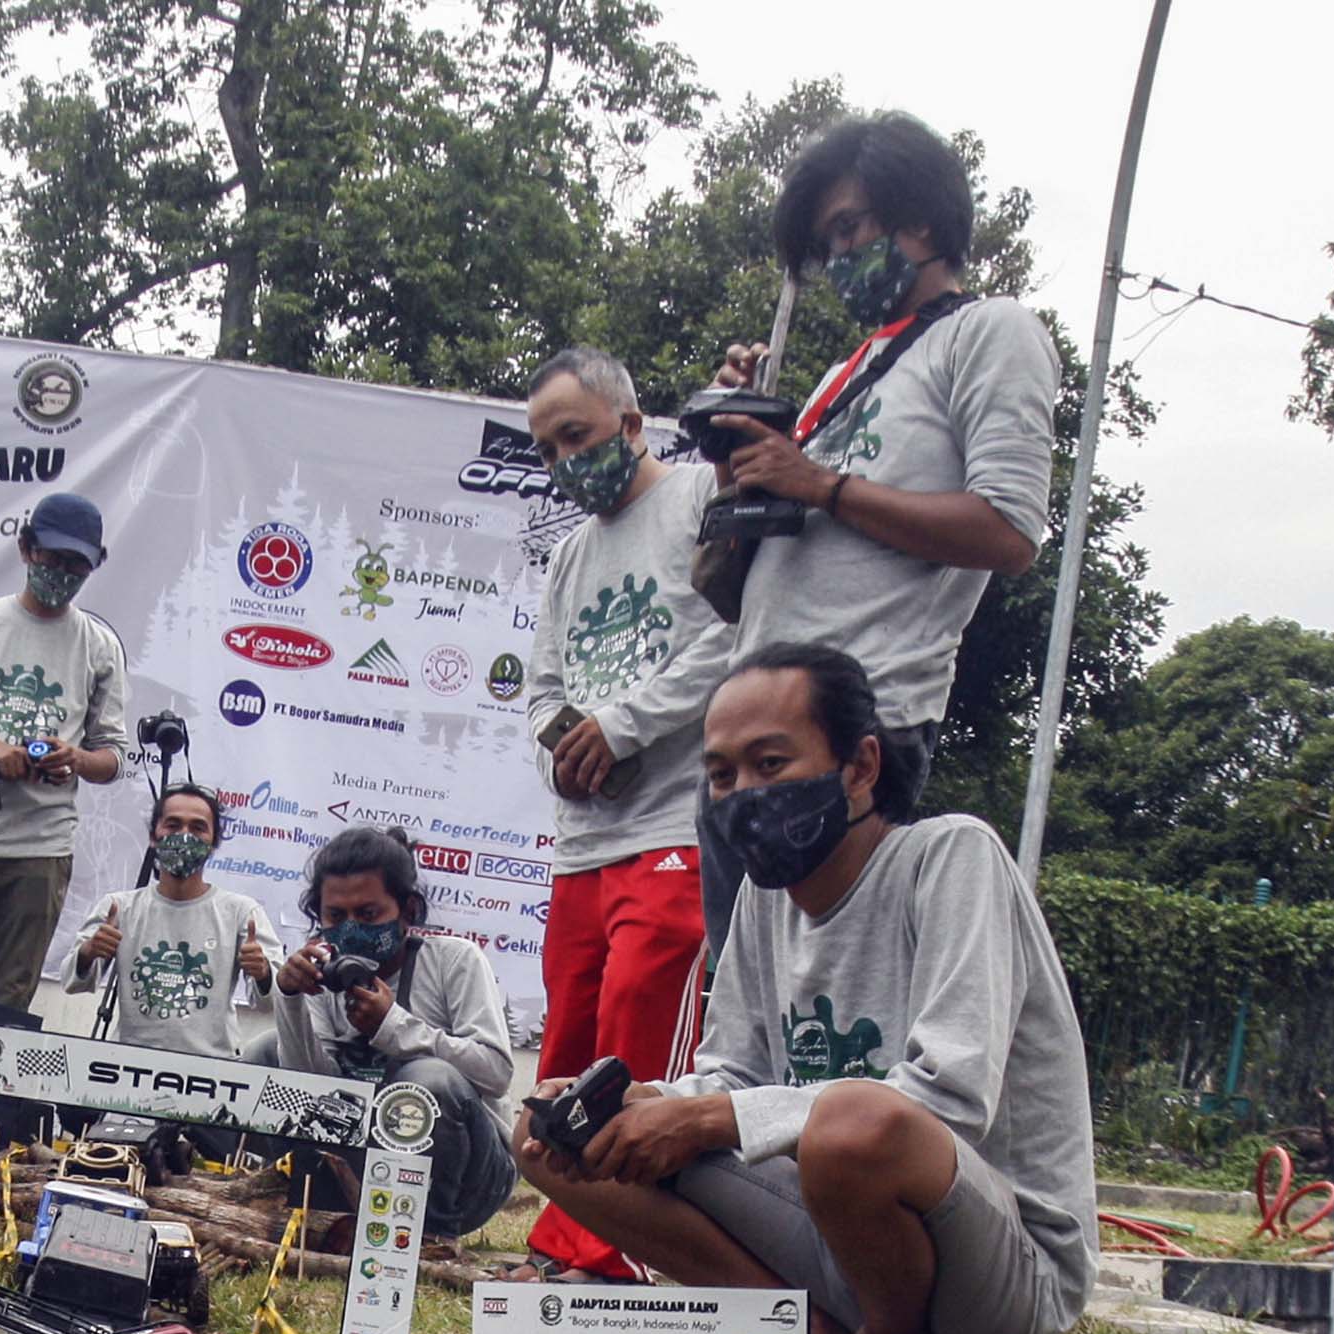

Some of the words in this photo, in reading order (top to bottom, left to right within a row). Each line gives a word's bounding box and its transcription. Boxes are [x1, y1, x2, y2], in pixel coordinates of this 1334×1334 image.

[379, 498, 480, 529] Sponsors:
[249, 580, 296, 600] SEMEN
[393, 568, 499, 597] BAPPENDA
[230, 597, 307, 617] INDOCEMENT
[222, 692, 262, 715] BSM
[289, 705, 321, 720] Bogor
[323, 710, 370, 728] Samudra
[371, 718, 405, 733] Media
[332, 771, 378, 792] Media
[382, 778, 450, 801] Partners:
[352, 807, 424, 828] ANTARA
[430, 818, 531, 847] BogorToday
[415, 845, 470, 872] etro
[481, 858, 546, 881] BOGOR
[88, 1060, 251, 1103] START
[570, 1297, 620, 1311] ADAPTASI
[623, 1299, 686, 1314] KEBIASAAN
[688, 1301, 719, 1315] BARU
[643, 1318, 690, 1331] Indonesia
